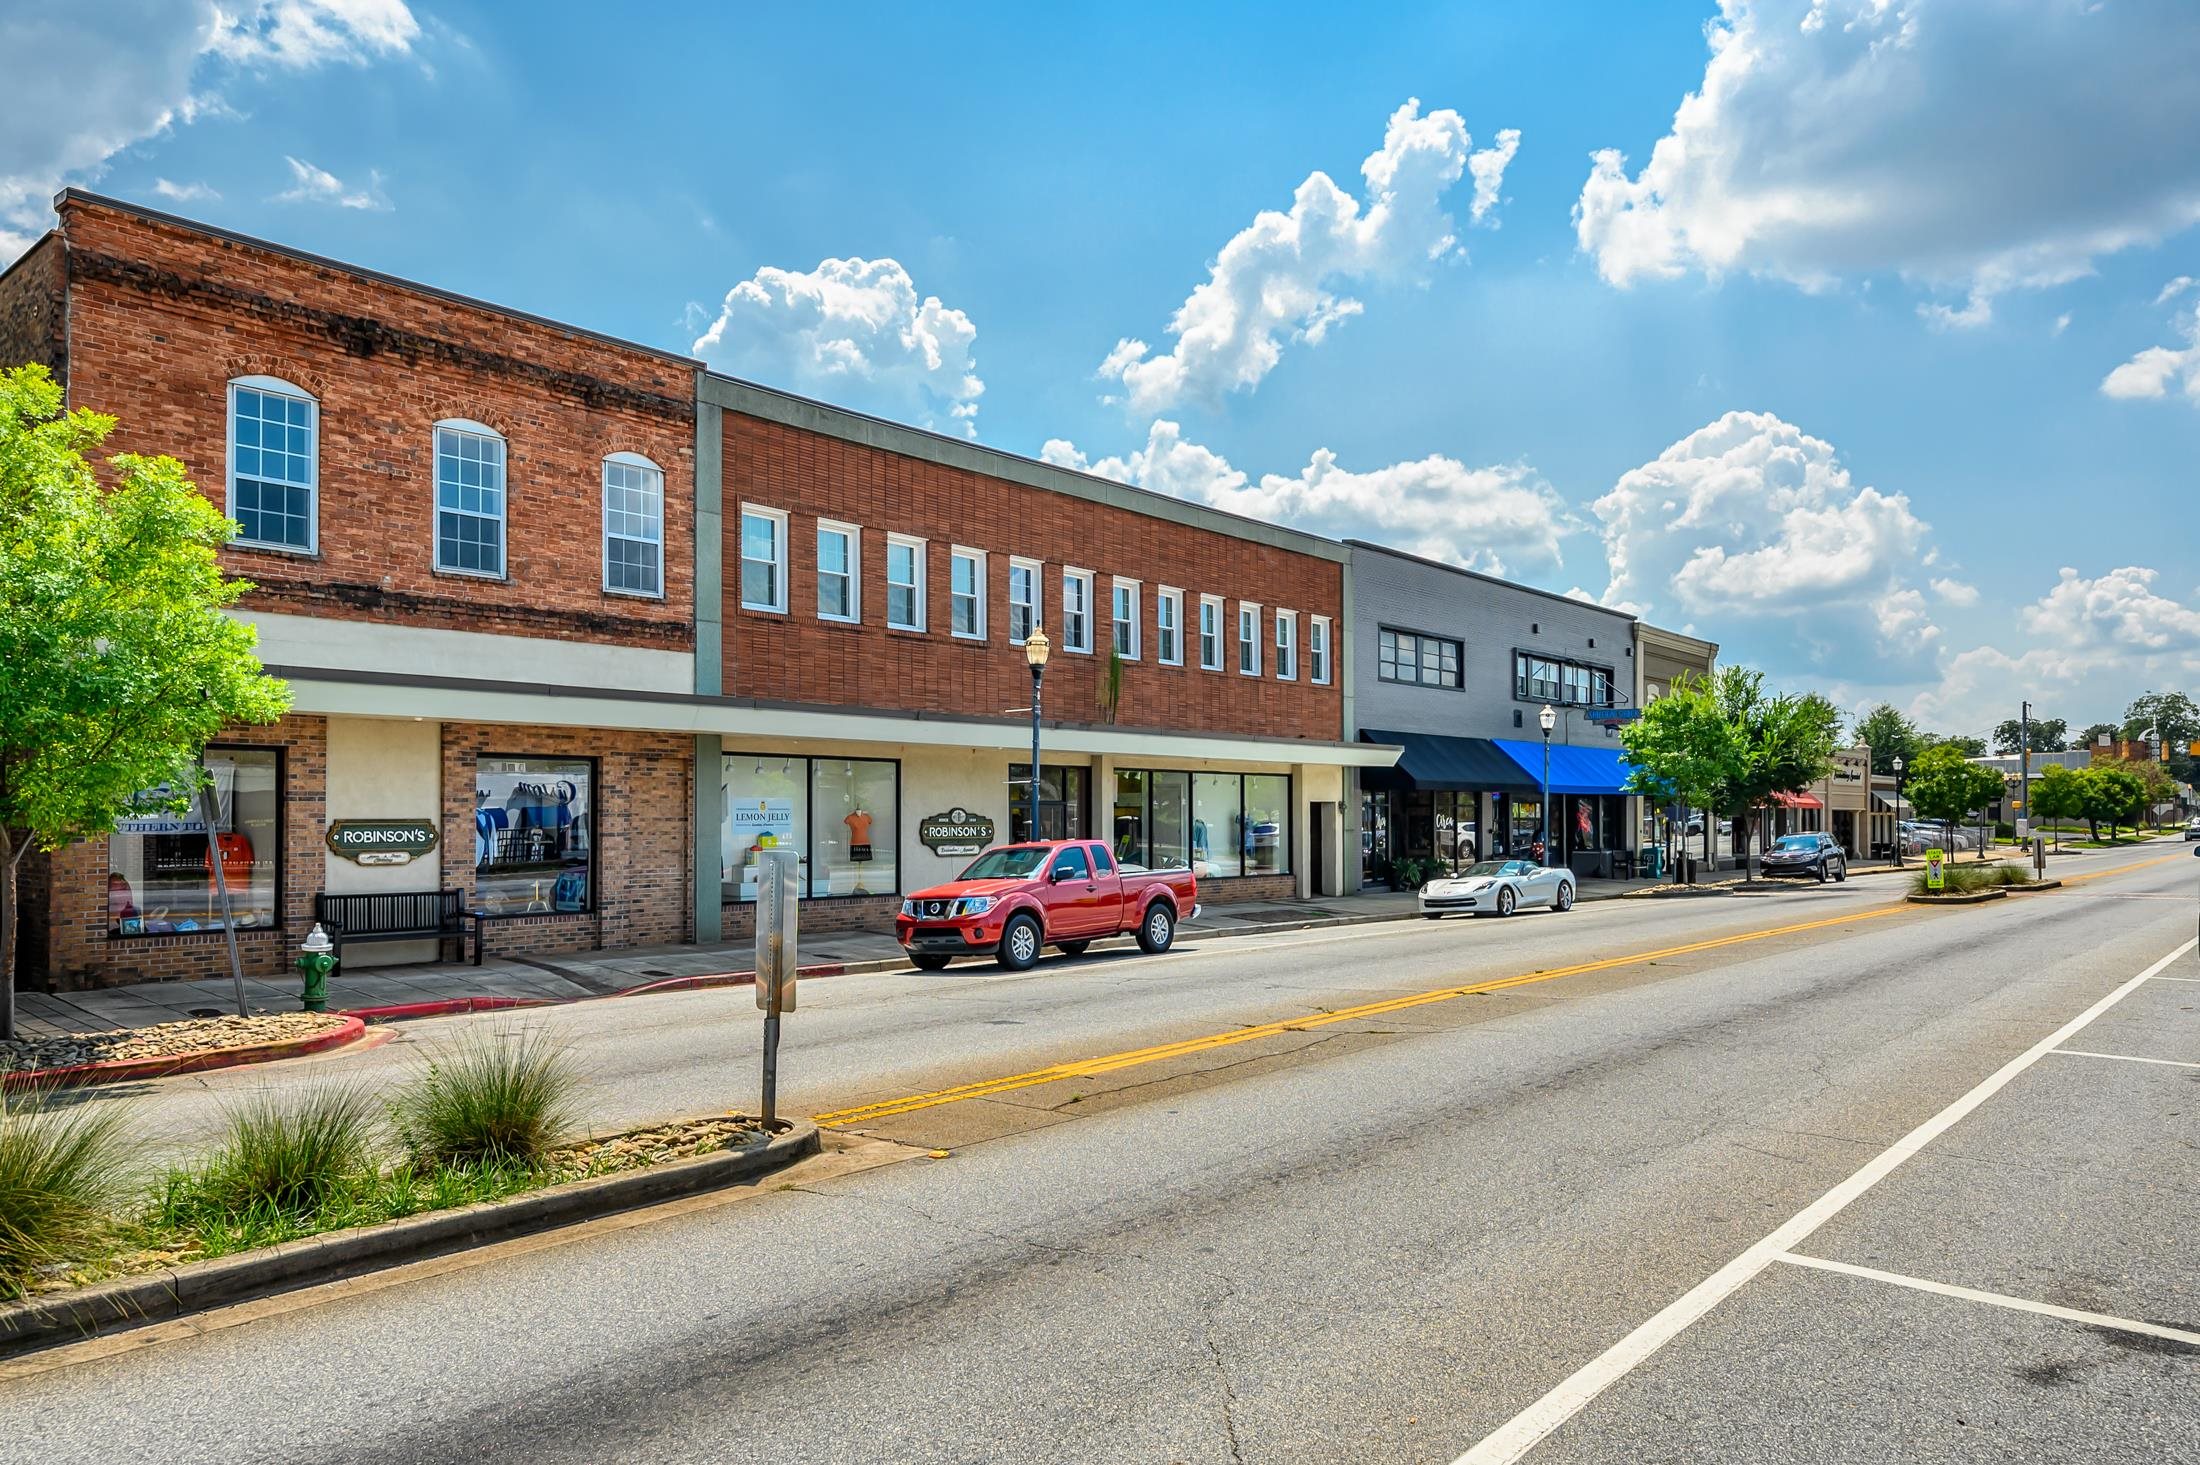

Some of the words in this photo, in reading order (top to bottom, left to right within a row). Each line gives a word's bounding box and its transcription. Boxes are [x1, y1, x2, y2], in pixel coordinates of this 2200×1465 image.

[736, 812, 766, 821] LEMON
[768, 812, 790, 823] JELLY
[118, 822, 180, 832] UTHERN
[929, 826, 987, 838] ROBINSON'S
[343, 828, 426, 843] ROBINSON'S
